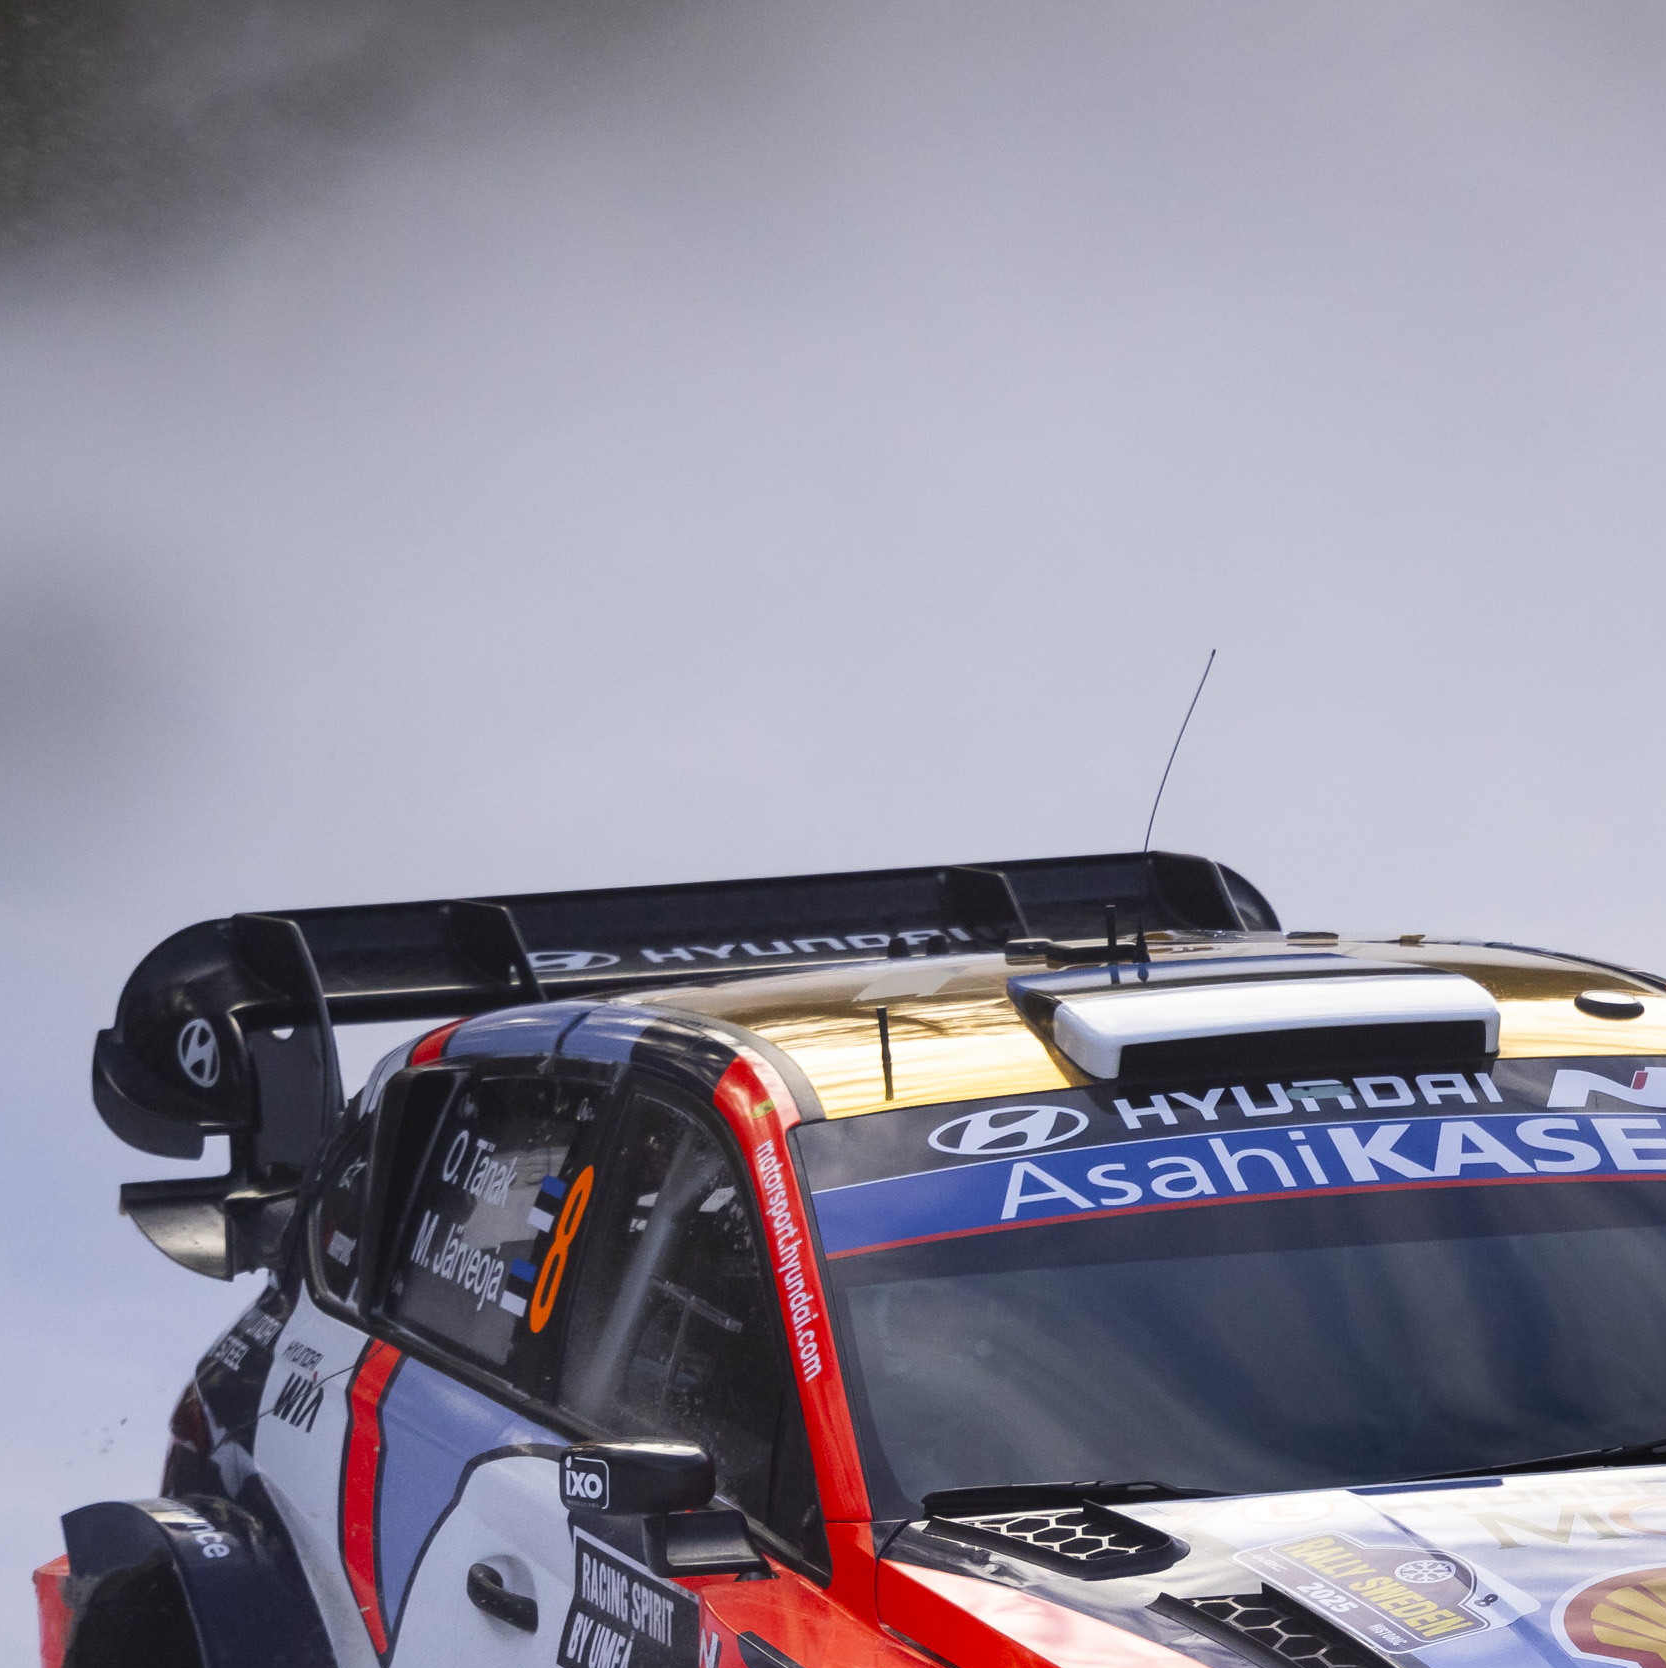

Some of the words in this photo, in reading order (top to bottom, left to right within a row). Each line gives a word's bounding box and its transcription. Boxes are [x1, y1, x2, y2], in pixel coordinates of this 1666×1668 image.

[641, 927, 974, 963] HYUNDAI
[1113, 1072, 1504, 1130] HYUNDAI
[529, 1164, 595, 1334] 8
[755, 1139, 823, 1383] motorsport.hyundai.com
[582, 1551, 630, 1623] RACING
[632, 1581, 675, 1648] SPIRIT
[1280, 1537, 1378, 1578] RALLY
[1348, 1575, 1474, 1637] SWEDEN
[1295, 1581, 1360, 1614] 2025
[566, 1611, 592, 1664] BY
